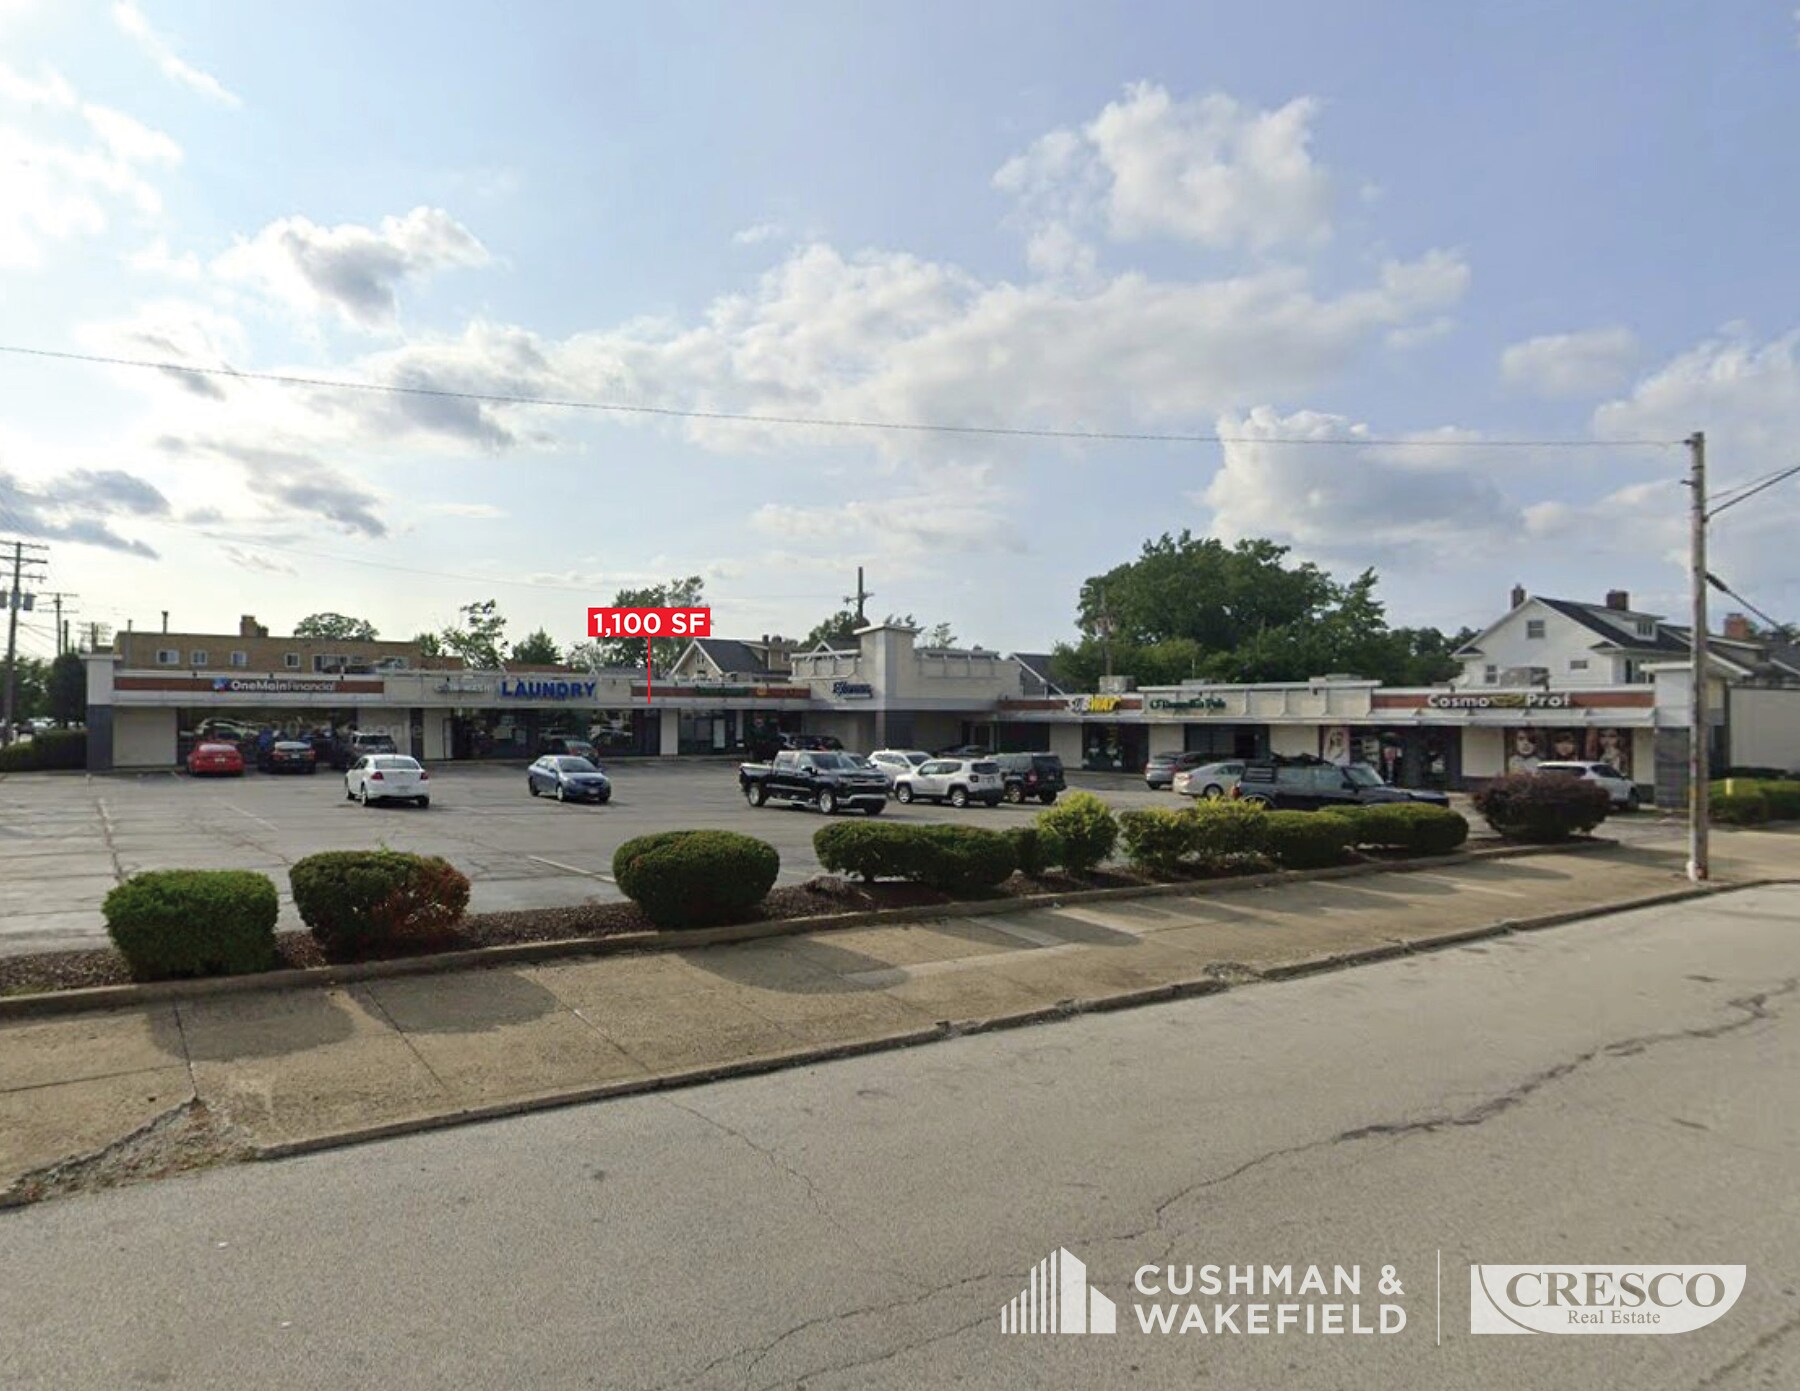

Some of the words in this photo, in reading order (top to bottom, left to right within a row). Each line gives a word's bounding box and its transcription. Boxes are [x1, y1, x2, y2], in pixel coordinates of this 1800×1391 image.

[501, 680, 596, 698] LAUNDRY
[1428, 694, 1490, 707] Cosmo
[1526, 693, 1570, 707] Prof
